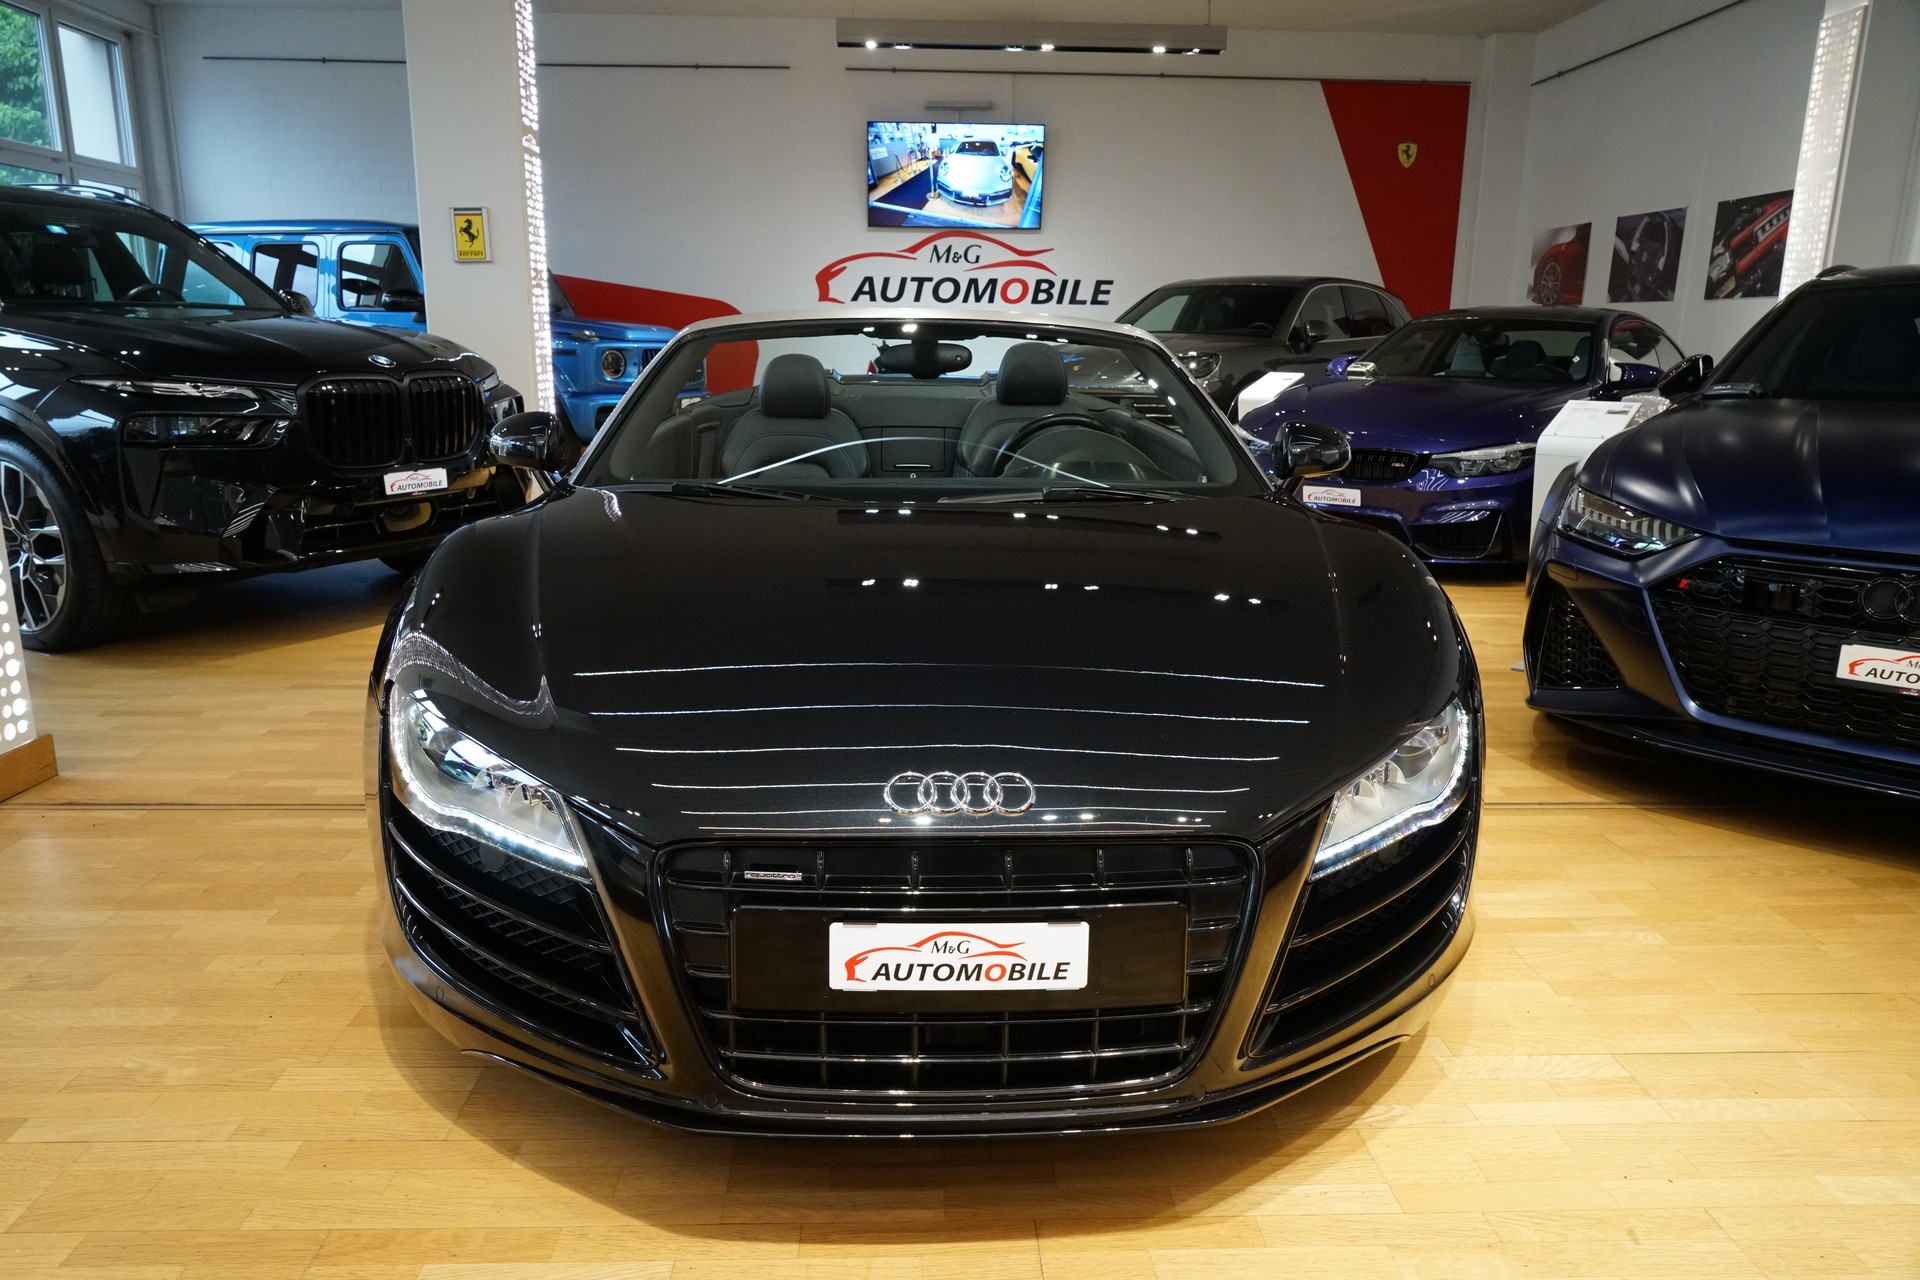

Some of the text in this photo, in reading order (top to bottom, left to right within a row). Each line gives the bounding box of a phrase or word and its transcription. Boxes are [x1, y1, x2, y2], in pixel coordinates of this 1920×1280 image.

[929, 244, 982, 264] M&G
[850, 276, 1114, 306] AUTOMOBILE
[397, 480, 442, 491] AUTOMOBILE
[1313, 495, 1356, 504] AUTOMOBILE
[931, 940, 971, 955] M&G
[871, 961, 1070, 982] AUTOMOBILE
